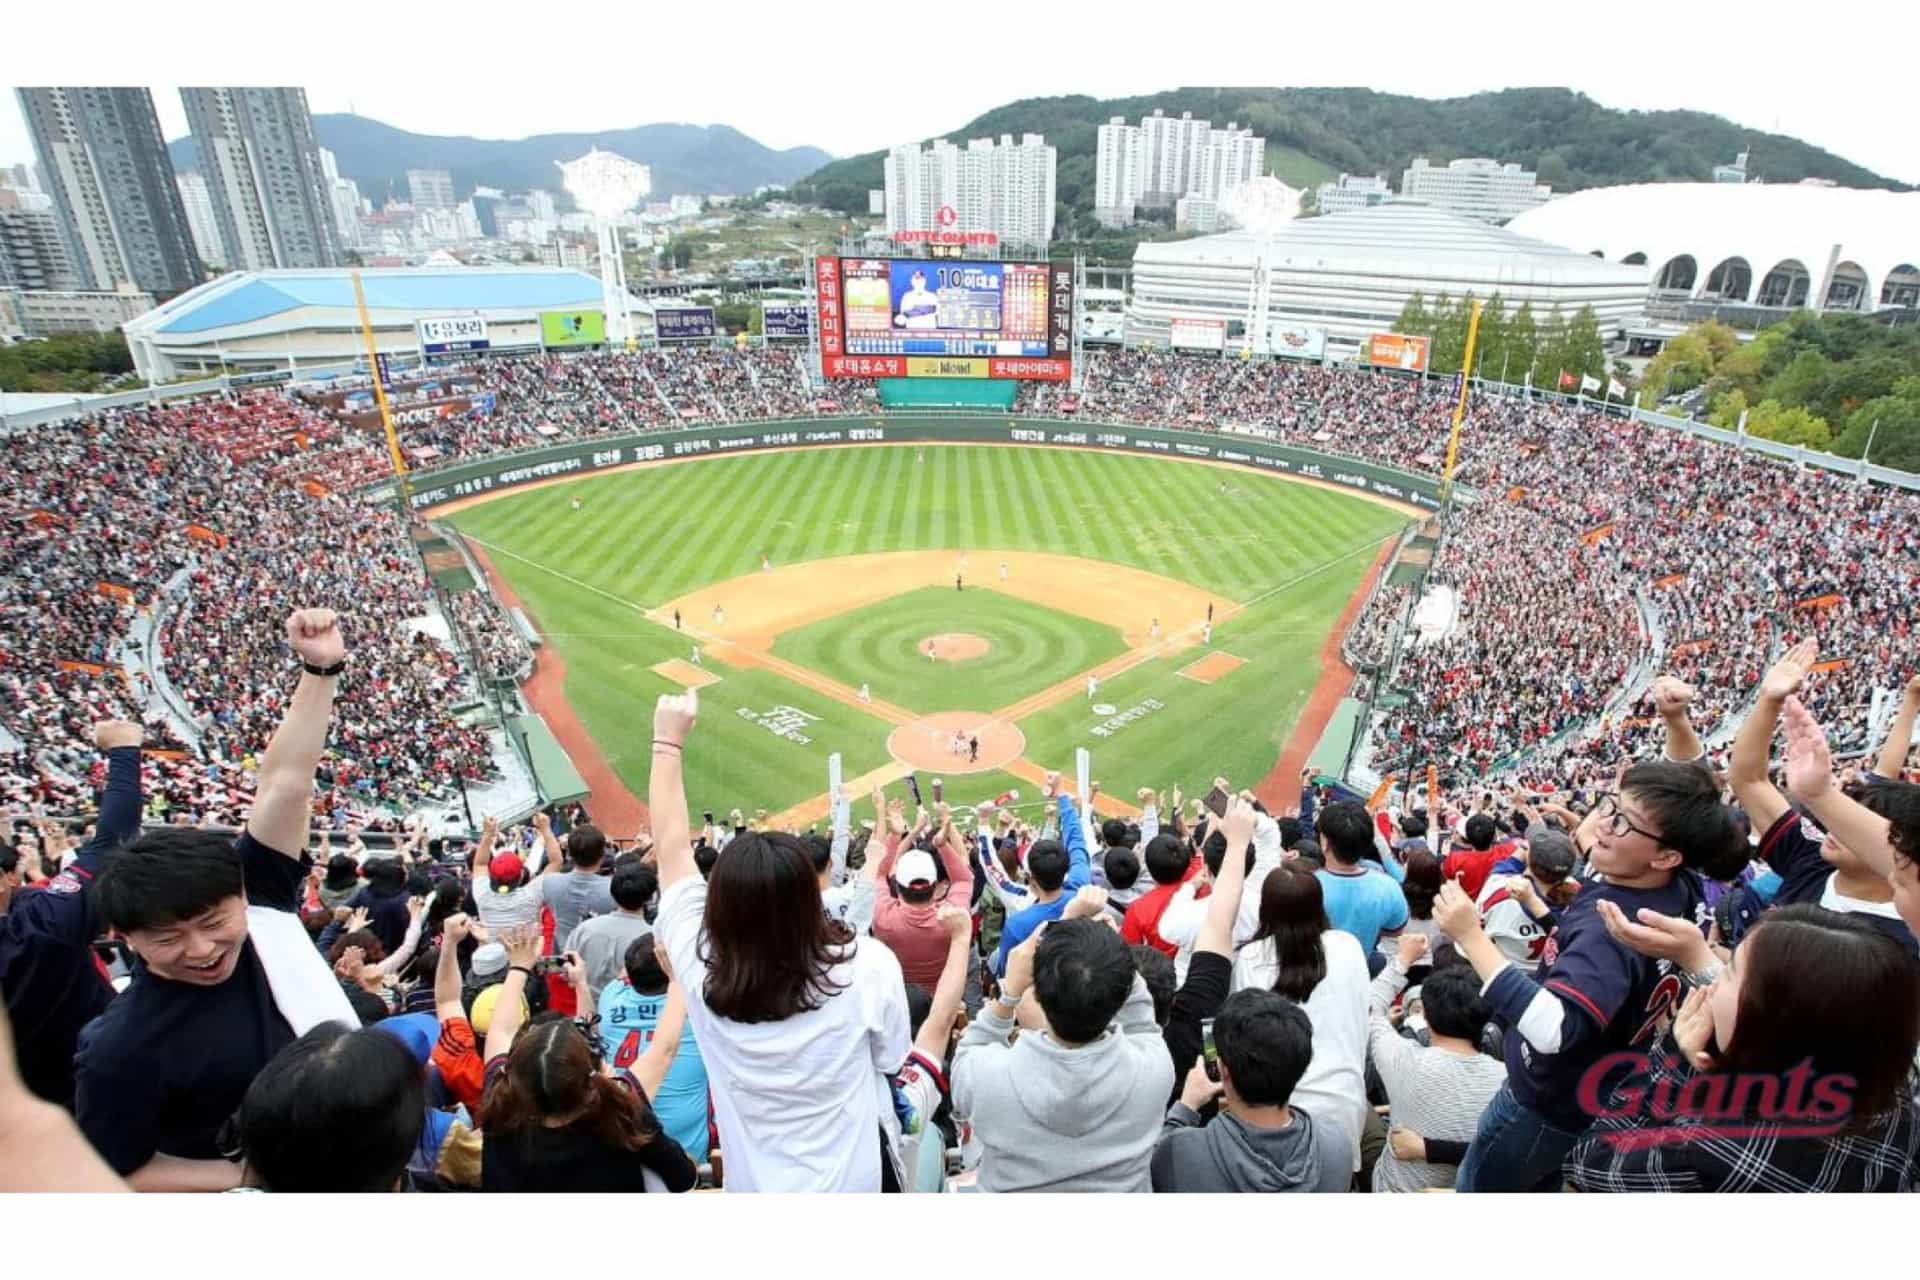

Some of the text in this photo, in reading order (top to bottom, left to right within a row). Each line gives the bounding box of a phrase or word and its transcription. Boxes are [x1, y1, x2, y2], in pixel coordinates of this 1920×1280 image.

[895, 230, 998, 245] LOTTE GIANTS
[937, 268, 962, 288] 10
[442, 320, 482, 337] 유보라
[832, 358, 899, 374] 롯데홈쇼핑
[995, 359, 1065, 374] 롯데하이마트
[610, 1004, 657, 1024] 강민
